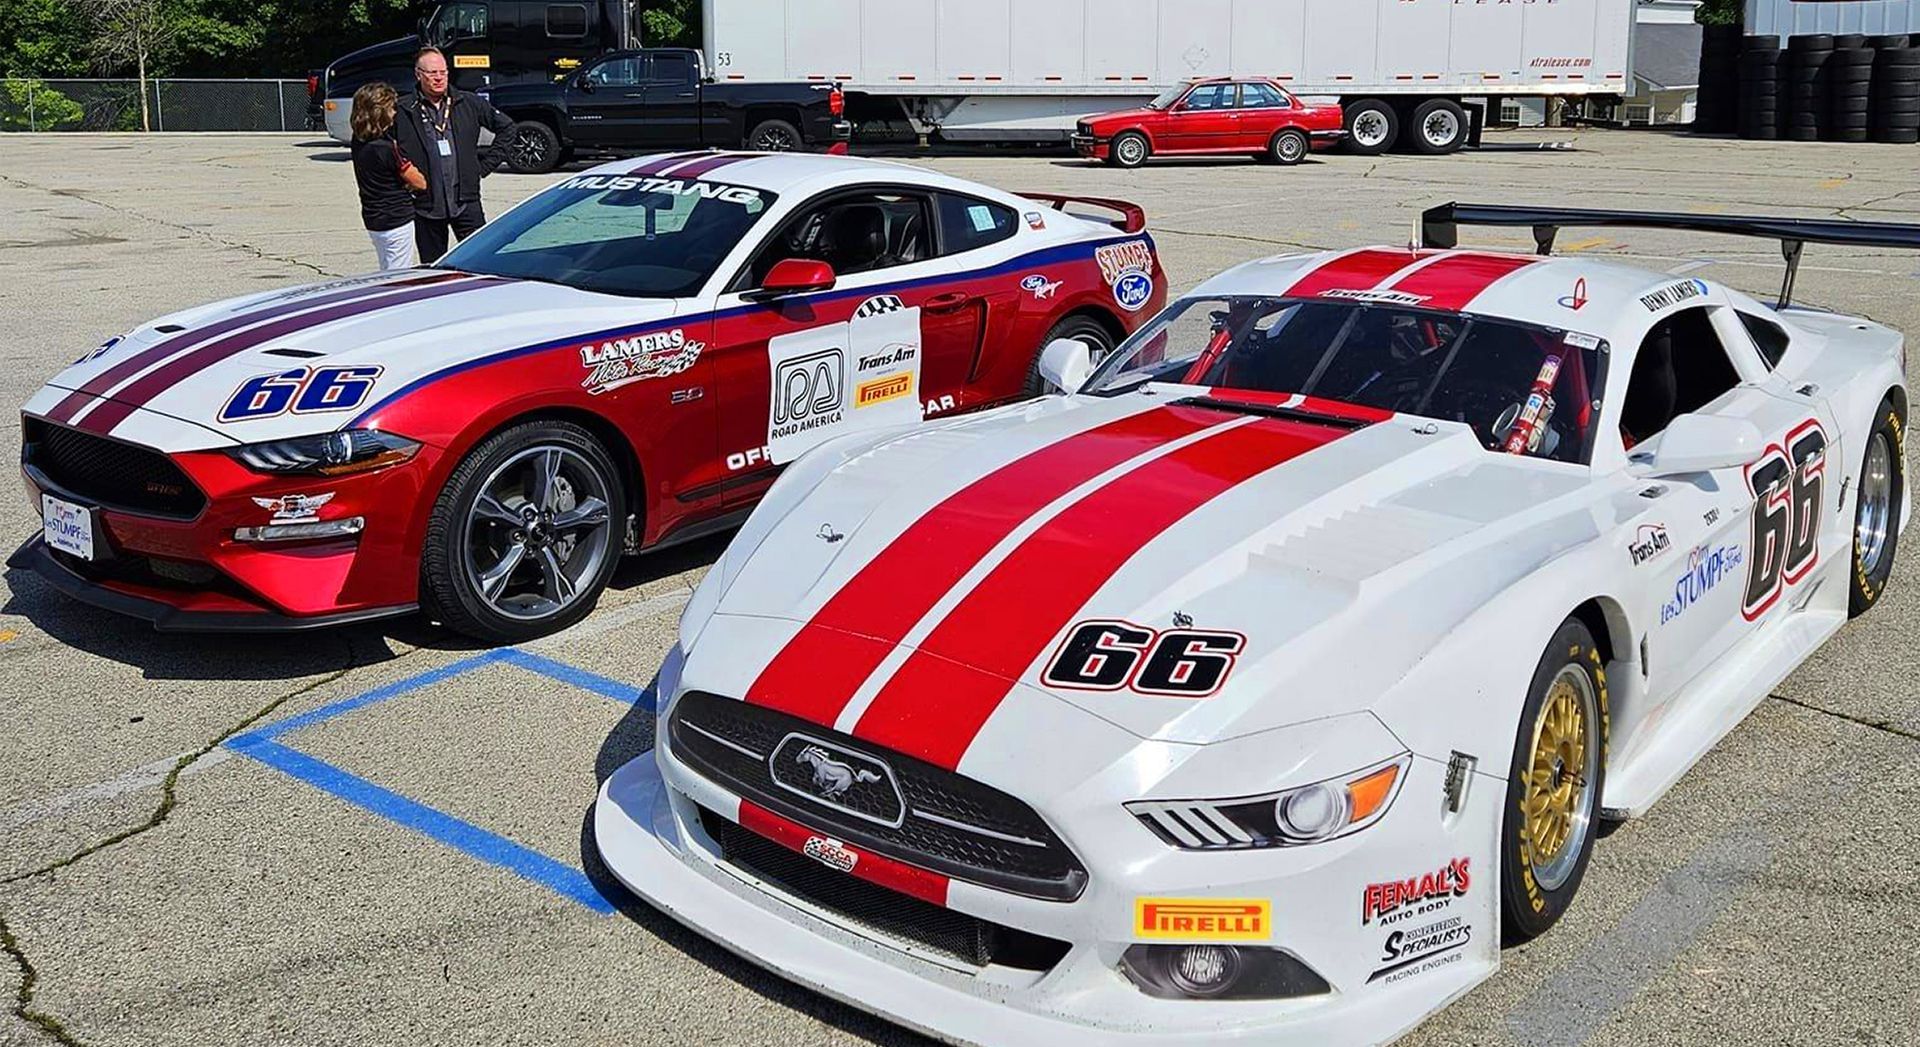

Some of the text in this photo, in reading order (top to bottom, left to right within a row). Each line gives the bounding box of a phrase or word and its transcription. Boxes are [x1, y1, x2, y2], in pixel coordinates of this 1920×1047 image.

[718, 52, 731, 66] 53
[559, 176, 760, 205] MUSTANG
[1119, 275, 1148, 305] Ford
[1640, 286, 1671, 312] DENNY
[581, 330, 684, 365] LAMERS
[858, 355, 892, 372] Trans
[893, 348, 915, 364] Am
[219, 366, 383, 421] 66
[860, 376, 908, 403] PIRELLI
[771, 411, 842, 440] ROAD AMERICA
[1744, 423, 1828, 615] 66
[1628, 541, 1653, 566] Trans
[1651, 531, 1670, 554] Am
[1661, 601, 1674, 625] Les
[1675, 547, 1724, 616] STUMPF
[1045, 621, 1243, 694] 66
[820, 844, 853, 864] SCCA
[1363, 857, 1471, 926] FEMAL'S
[1143, 903, 1262, 933] PIRELLI
[1380, 899, 1451, 927] AUTO BODY
[1382, 924, 1471, 962] SPECIALISTS
[1384, 952, 1462, 984] RACING ENGINES
